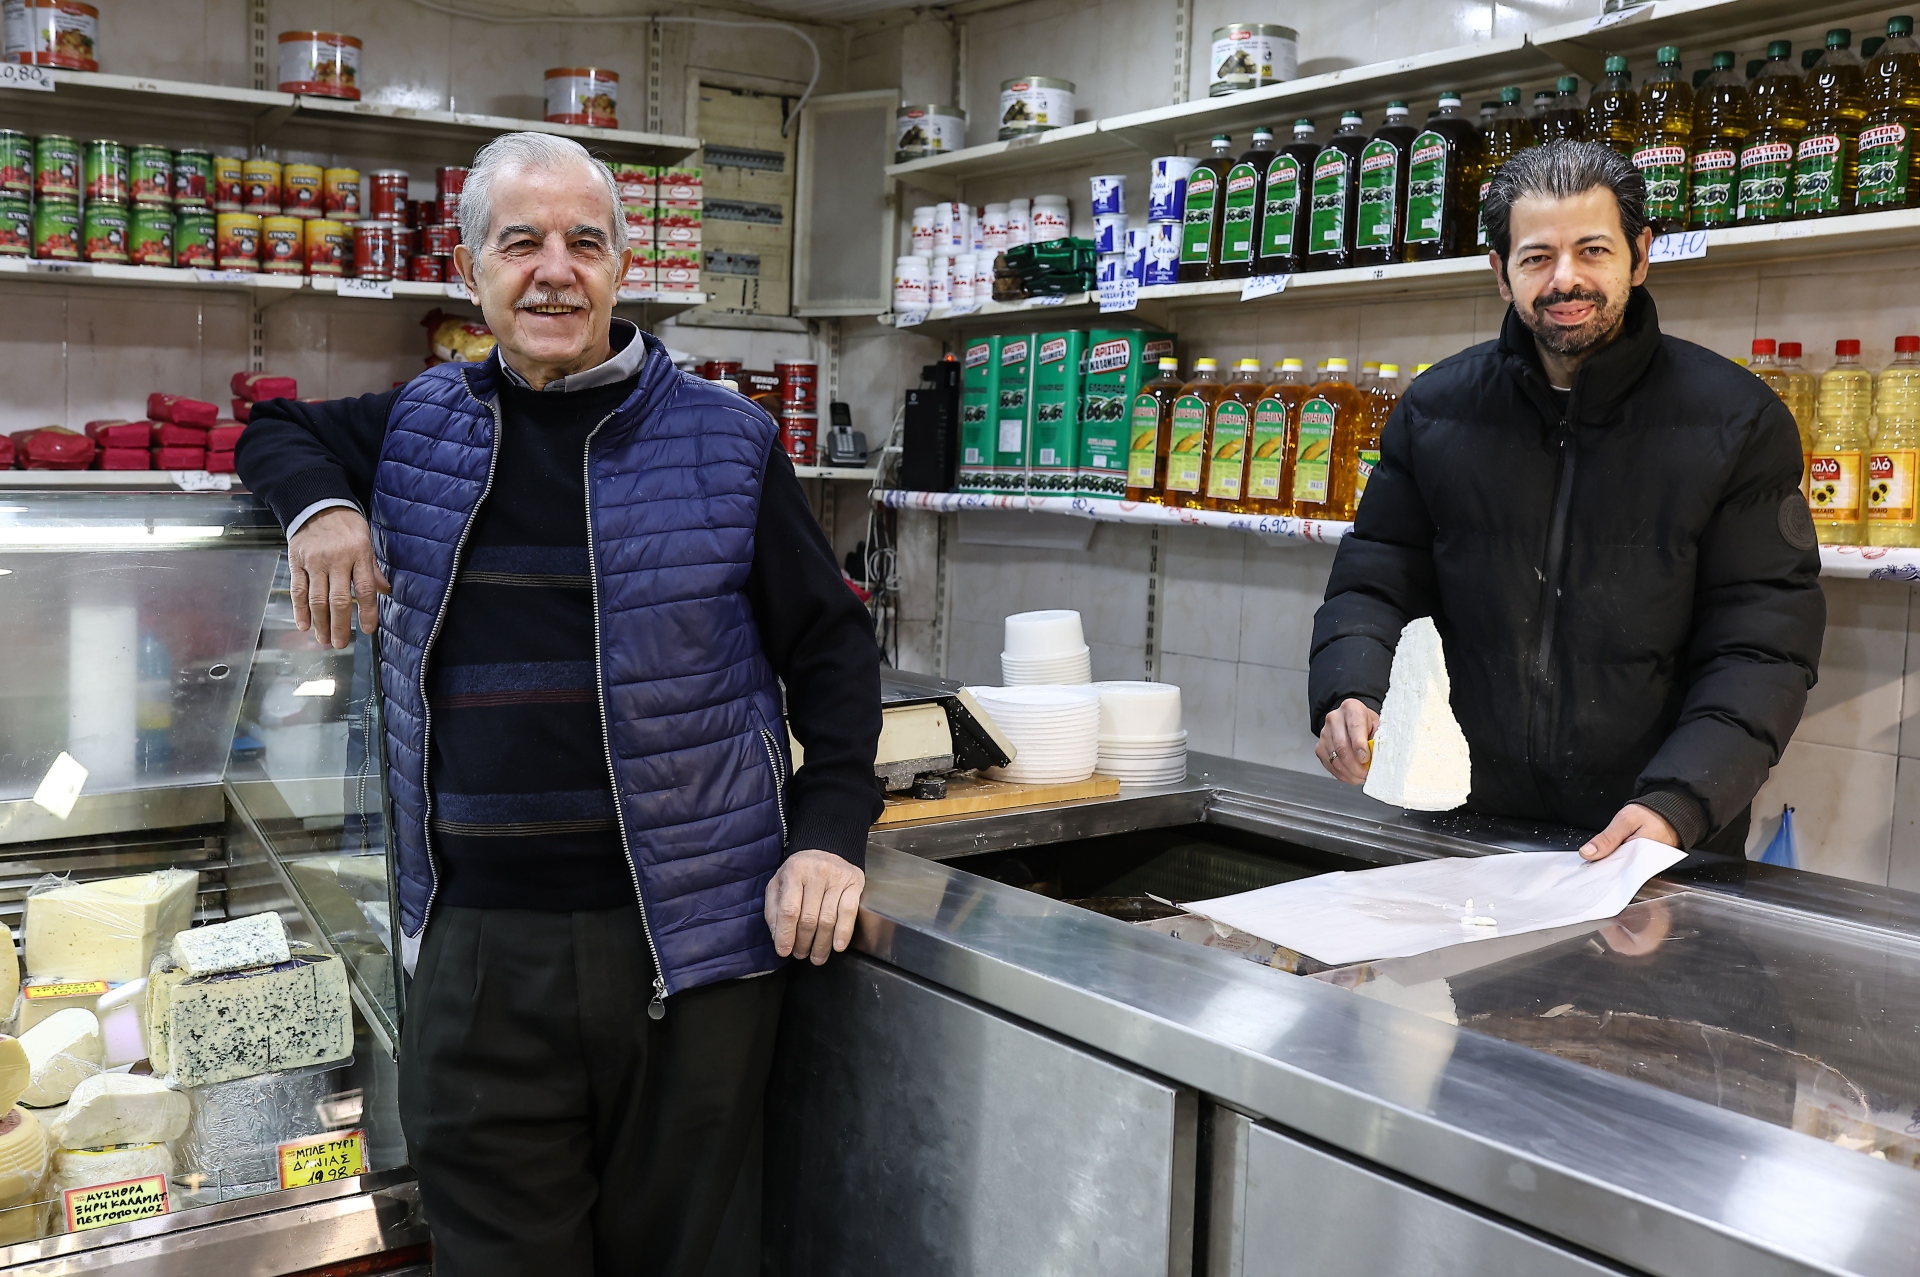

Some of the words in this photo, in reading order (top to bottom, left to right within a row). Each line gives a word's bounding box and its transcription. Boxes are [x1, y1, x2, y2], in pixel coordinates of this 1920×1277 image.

[0, 65, 42, 84] 0,80
[1094, 342, 1126, 358] ΑΡΙΣΤΟΝ
[1870, 457, 1891, 471] αλό
[296, 1144, 326, 1159] ΜΠΛΕ
[328, 1138, 354, 1151] ΤΥΡΙ
[86, 1184, 144, 1203] ΜΥΖΗΘΡΑ
[75, 1201, 108, 1216] ΞΗΡΗ
[76, 1203, 164, 1226] ΠΕΤΡΟΠΟΥΛΟΣ
